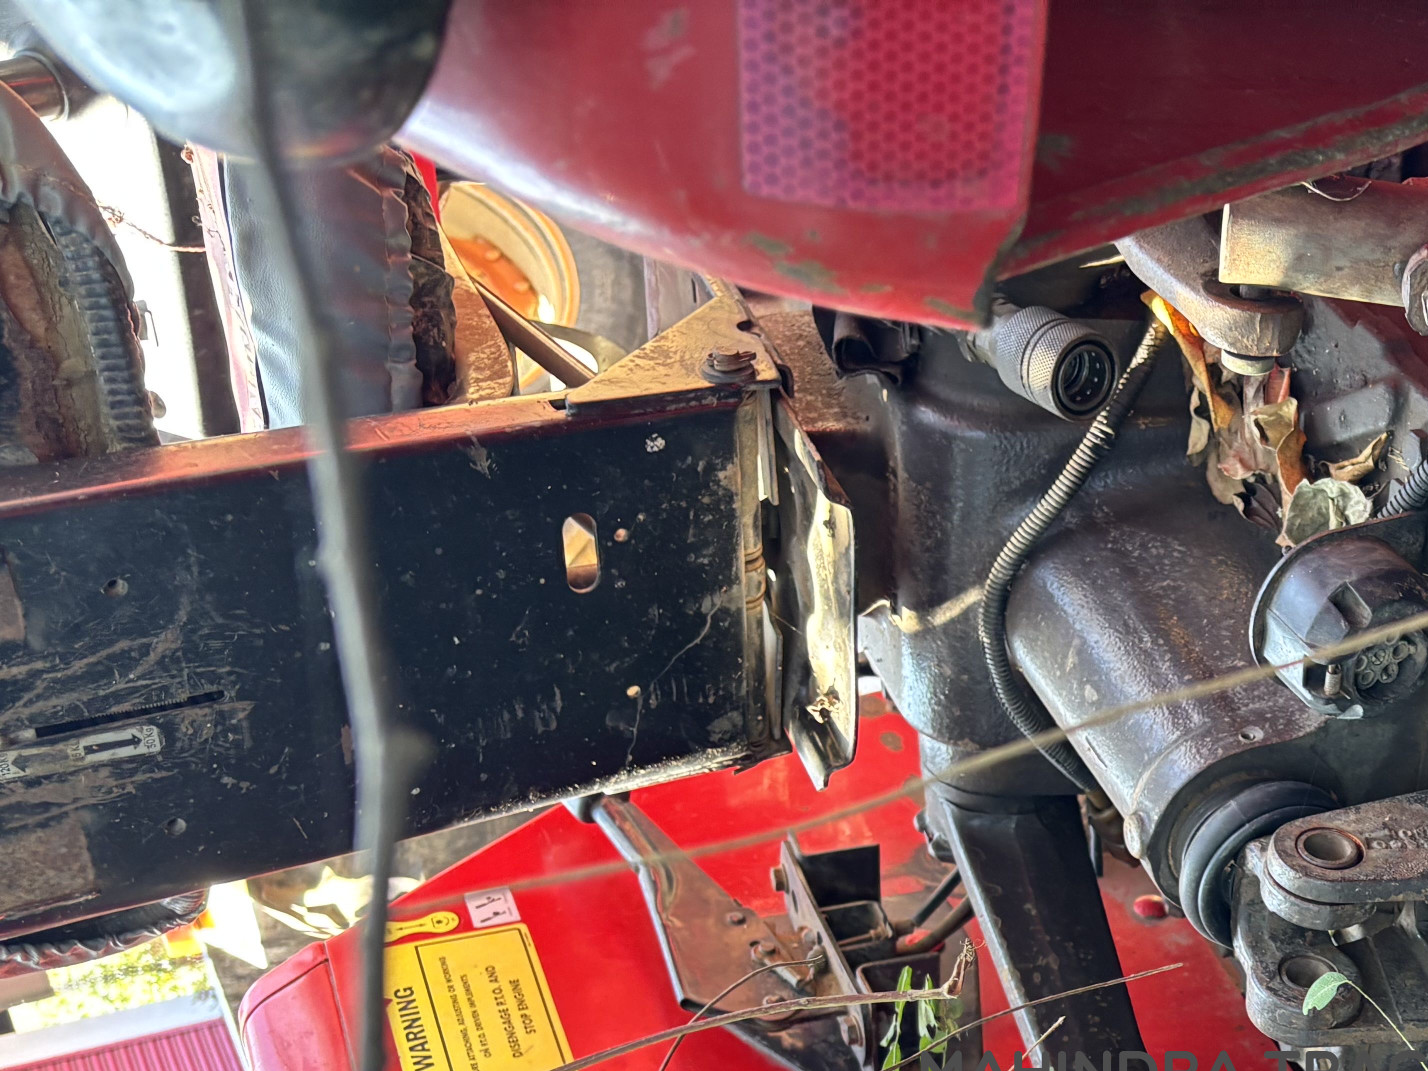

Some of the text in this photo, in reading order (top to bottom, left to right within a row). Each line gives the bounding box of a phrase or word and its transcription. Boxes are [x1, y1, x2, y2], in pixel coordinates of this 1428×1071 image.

[438, 956, 453, 984] WORKING
[447, 984, 456, 993] OR
[460, 974, 477, 1009] IMPLEMENTS
[450, 994, 466, 1026] ADJUSTING
[471, 1010, 484, 1031] DRIVEN
[485, 965, 524, 1059] DISENGAGE P.T.O. AND
[509, 978, 537, 1035] STOP ENGINE
